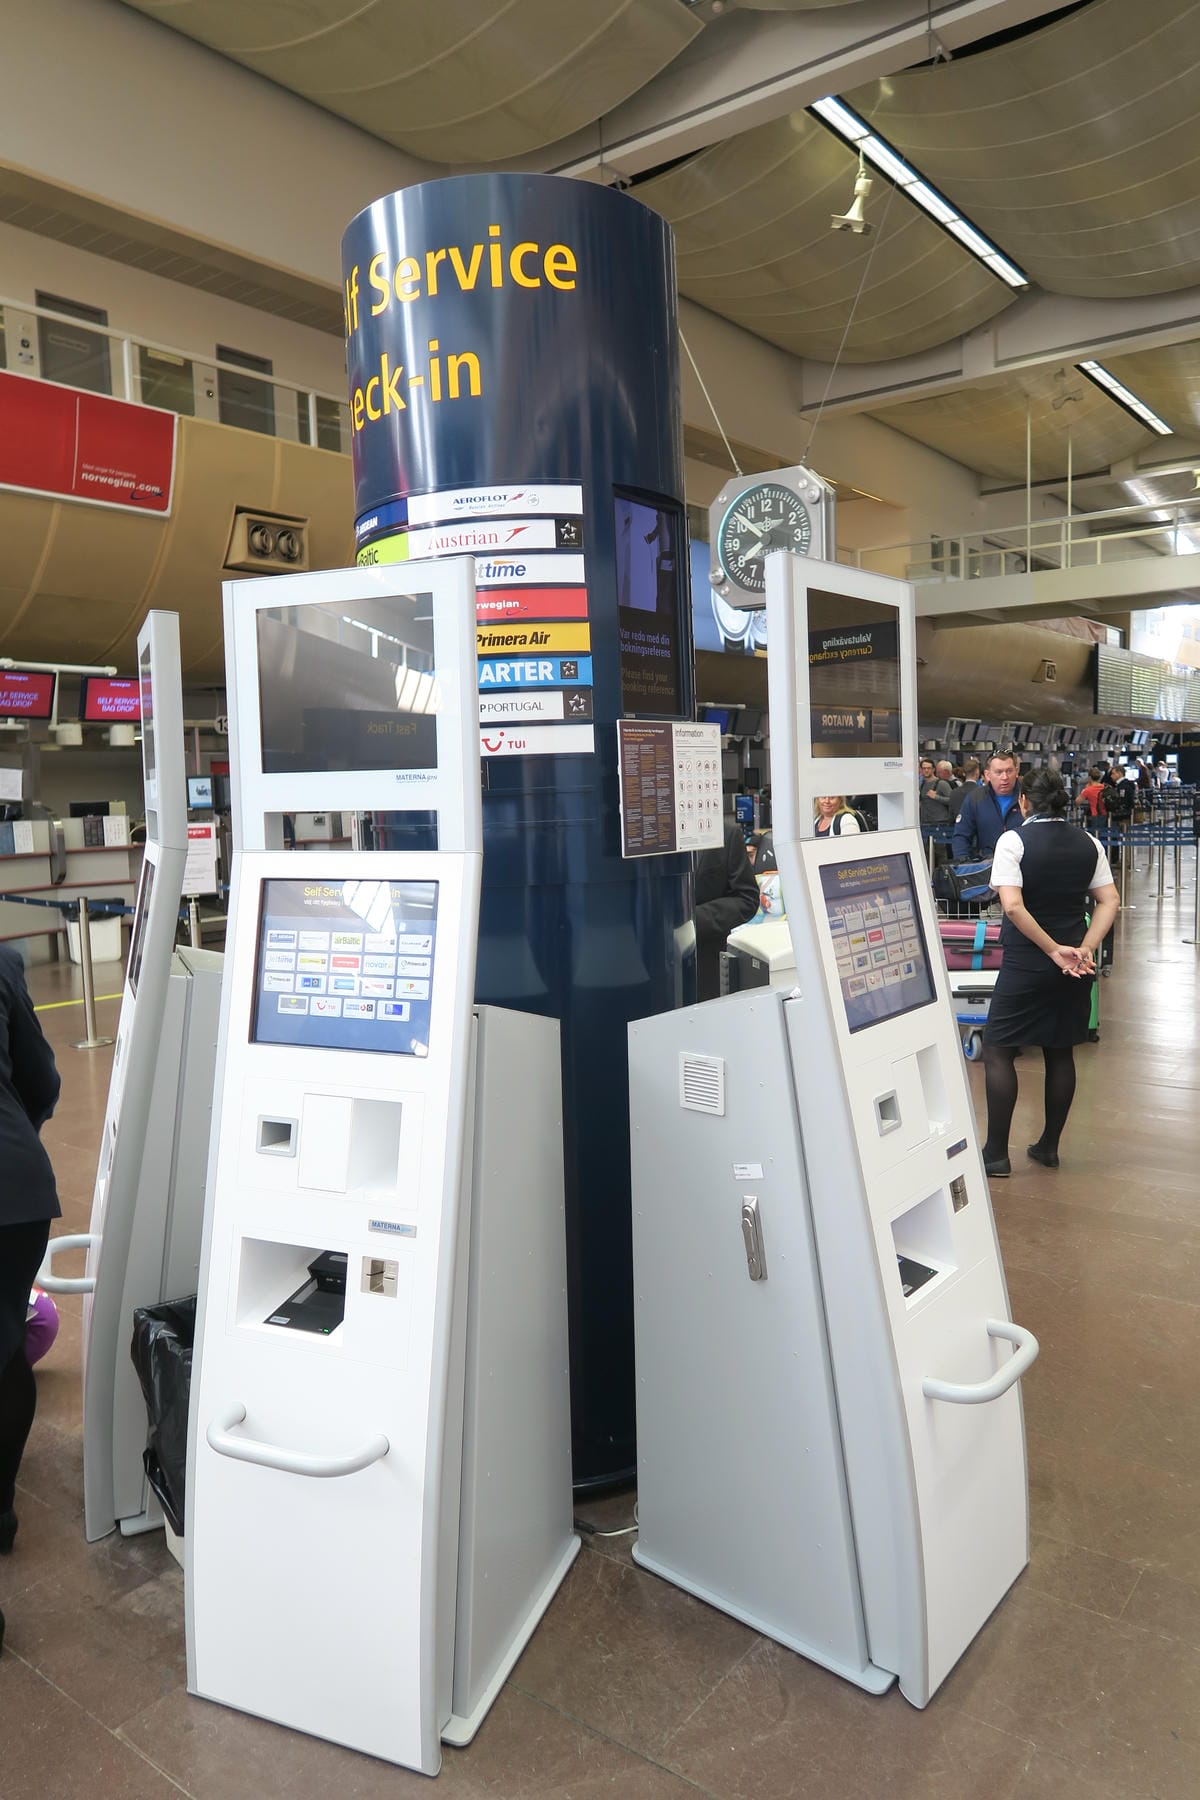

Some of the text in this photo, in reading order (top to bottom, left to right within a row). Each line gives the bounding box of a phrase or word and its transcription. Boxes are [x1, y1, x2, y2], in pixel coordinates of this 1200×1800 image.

[344, 224, 577, 336] lf Service
[350, 339, 482, 437] eck-in
[81, 472, 161, 493] norwegian.com
[453, 494, 508, 504] AEROFLOT
[761, 499, 772, 512] 12
[788, 512, 797, 525] 2
[428, 530, 499, 550] Austrian
[793, 528, 802, 542] 3
[732, 538, 740, 551] 9
[738, 555, 746, 567] 8
[475, 562, 527, 578] ttime
[749, 564, 757, 577] 7
[476, 599, 520, 610] rwegian
[477, 631, 551, 647] Primera Air
[632, 630, 646, 641] redo
[647, 633, 659, 644] med
[661, 634, 670, 645] din
[620, 640, 671, 658] bokningsreferens
[479, 661, 554, 683] ARTER
[643, 669, 654, 681] find
[10, 692, 39, 700] SERVICE
[648, 684, 675, 696] reference
[97, 696, 139, 706] SELF SERVICE
[102, 703, 135, 712] BAG DROP
[487, 701, 545, 713] PORTUGAL
[675, 728, 704, 738] Information
[507, 740, 526, 749] TUI
[304, 886, 321, 897] Self
[371, 1220, 401, 1231] MATERNA
